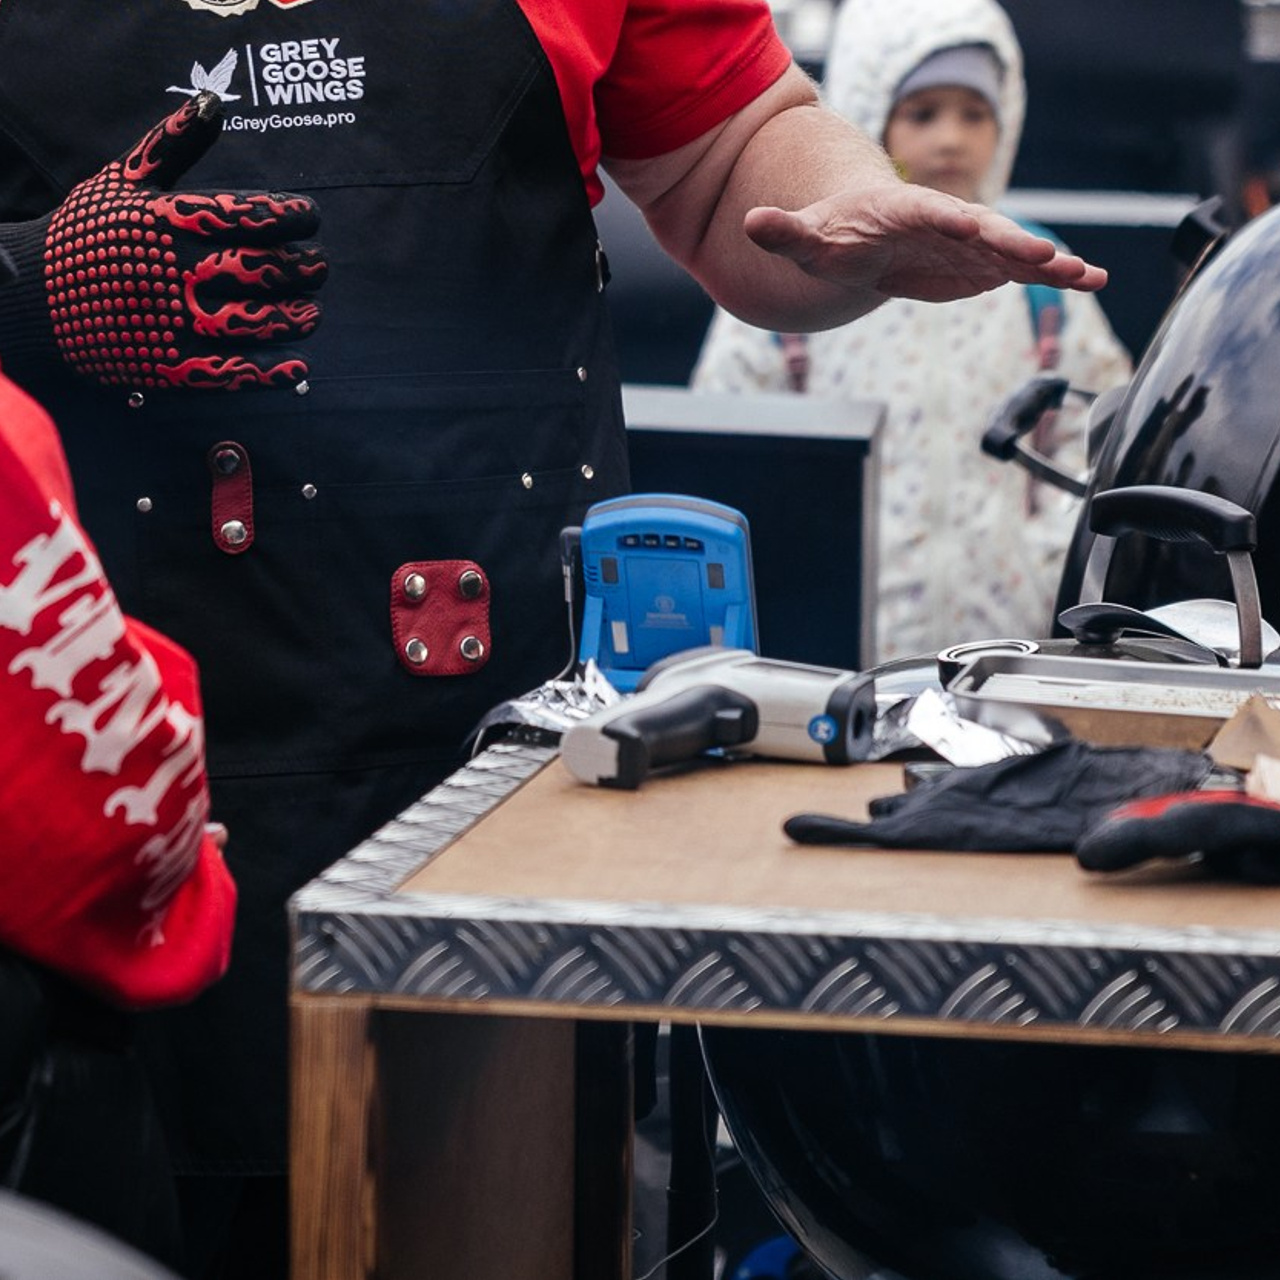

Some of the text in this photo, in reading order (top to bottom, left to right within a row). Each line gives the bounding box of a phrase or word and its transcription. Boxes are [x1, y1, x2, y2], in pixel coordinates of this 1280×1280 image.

[260, 38, 340, 63] GREY
[262, 56, 366, 83] GOOSE
[264, 79, 364, 106] WINGS
